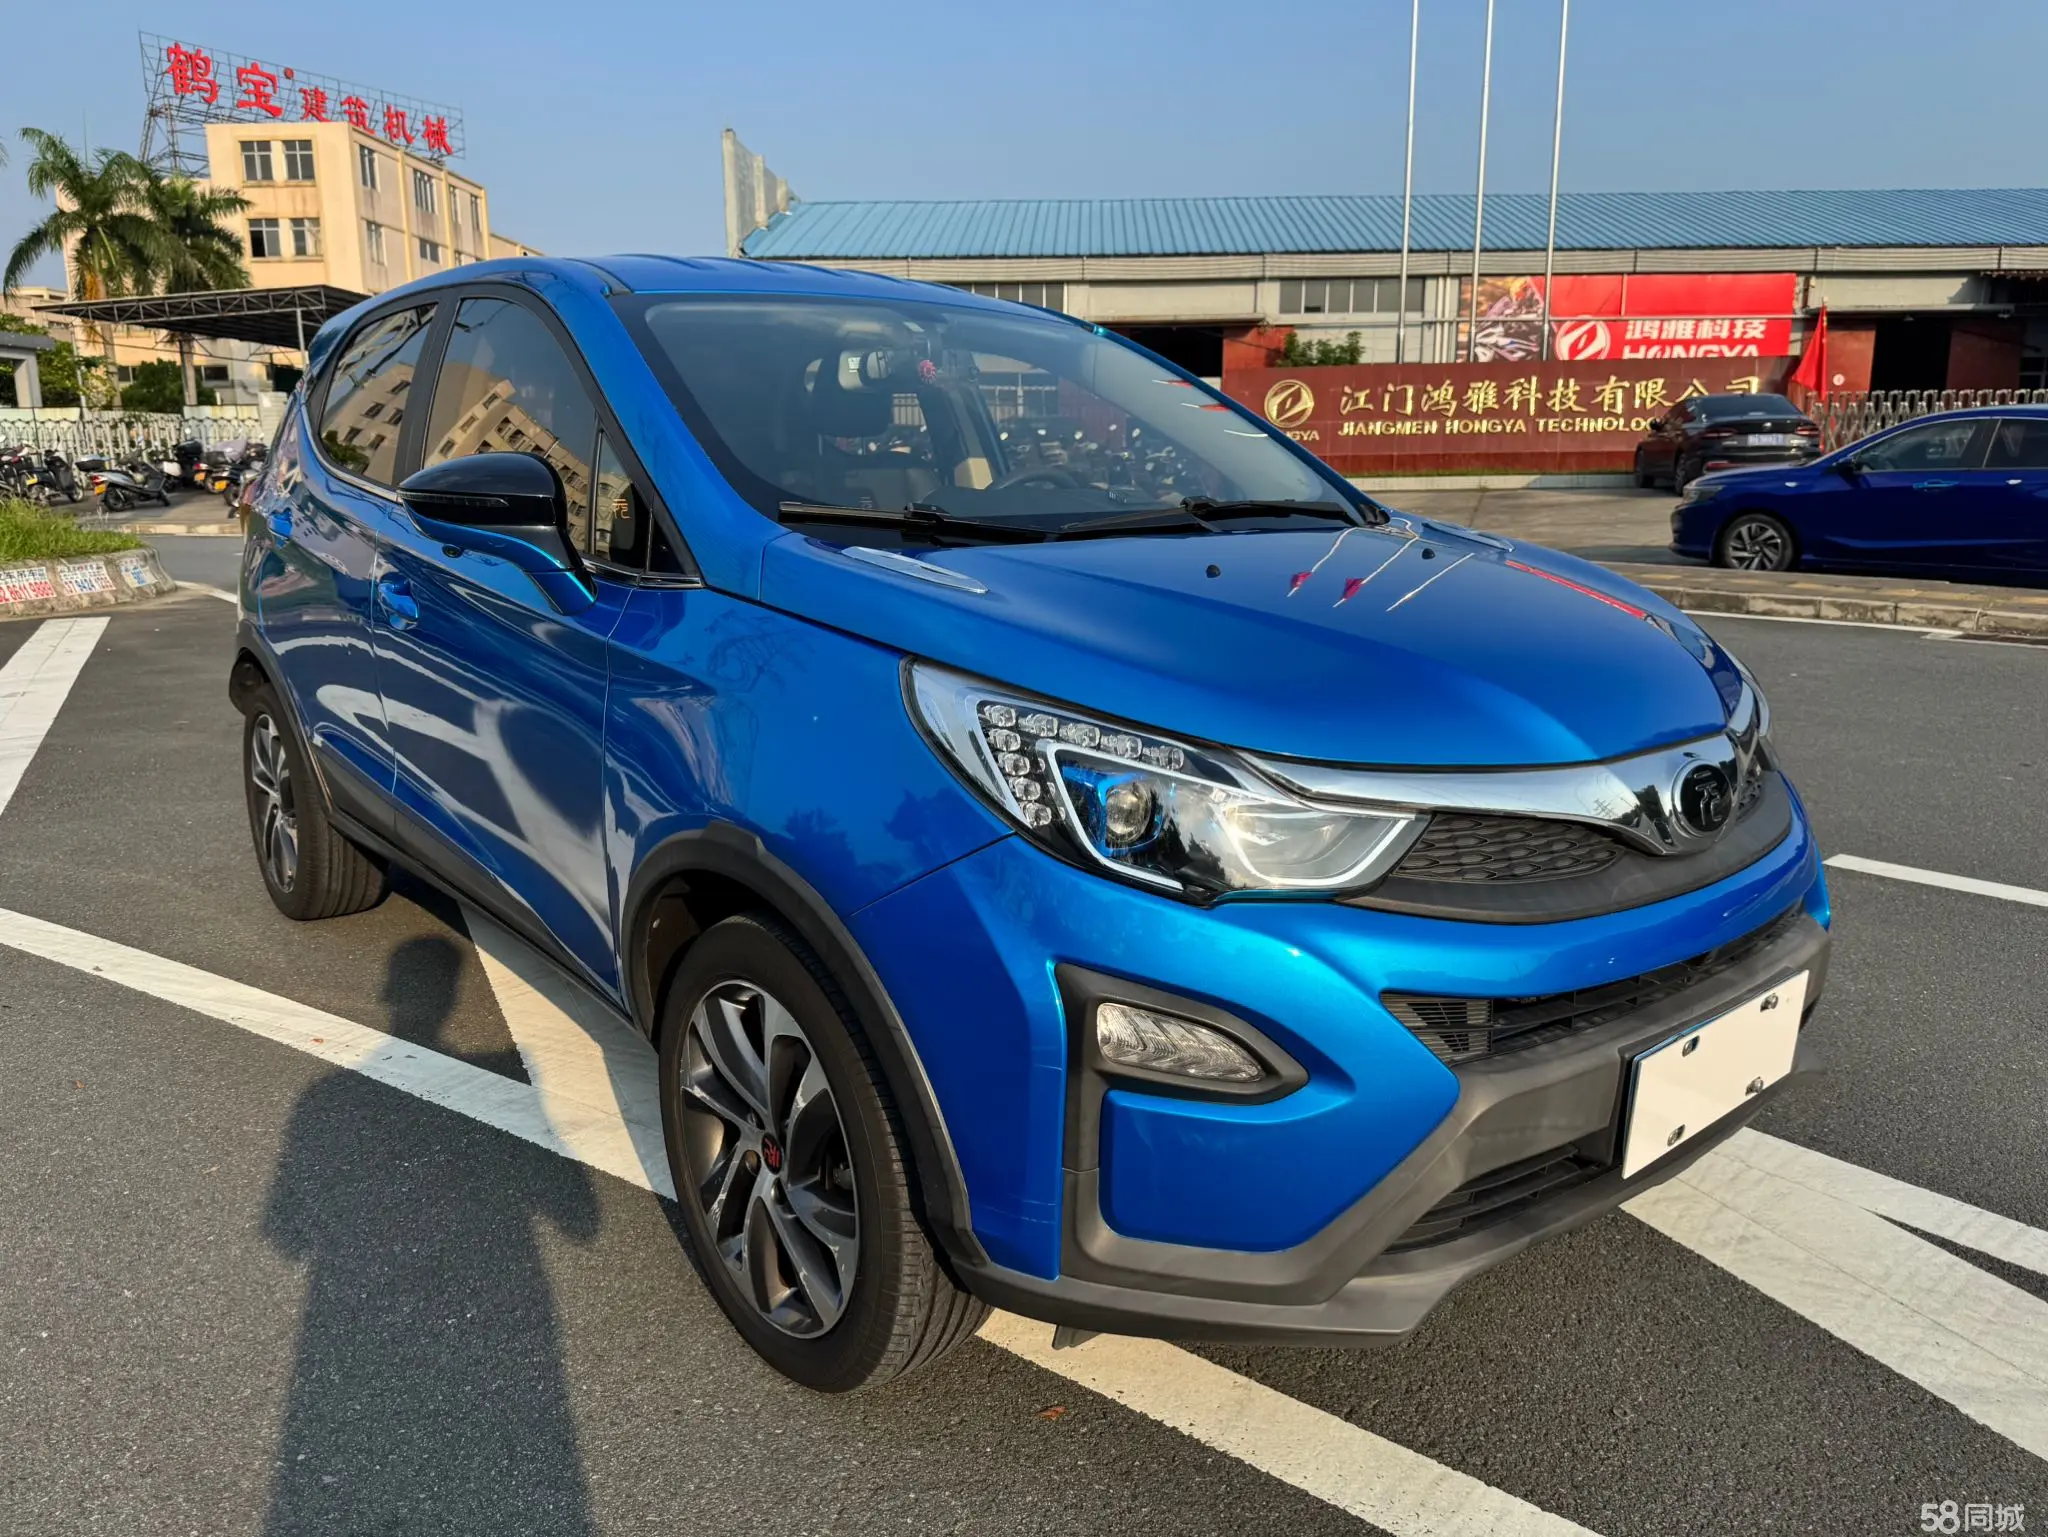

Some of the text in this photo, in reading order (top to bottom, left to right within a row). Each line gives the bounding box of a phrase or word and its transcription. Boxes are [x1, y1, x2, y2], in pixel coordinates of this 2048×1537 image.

[1625, 319, 1768, 340] 鸿雅科技
[1338, 420, 1438, 436] JIANGMEN
[1445, 419, 1527, 434] HONGYA
